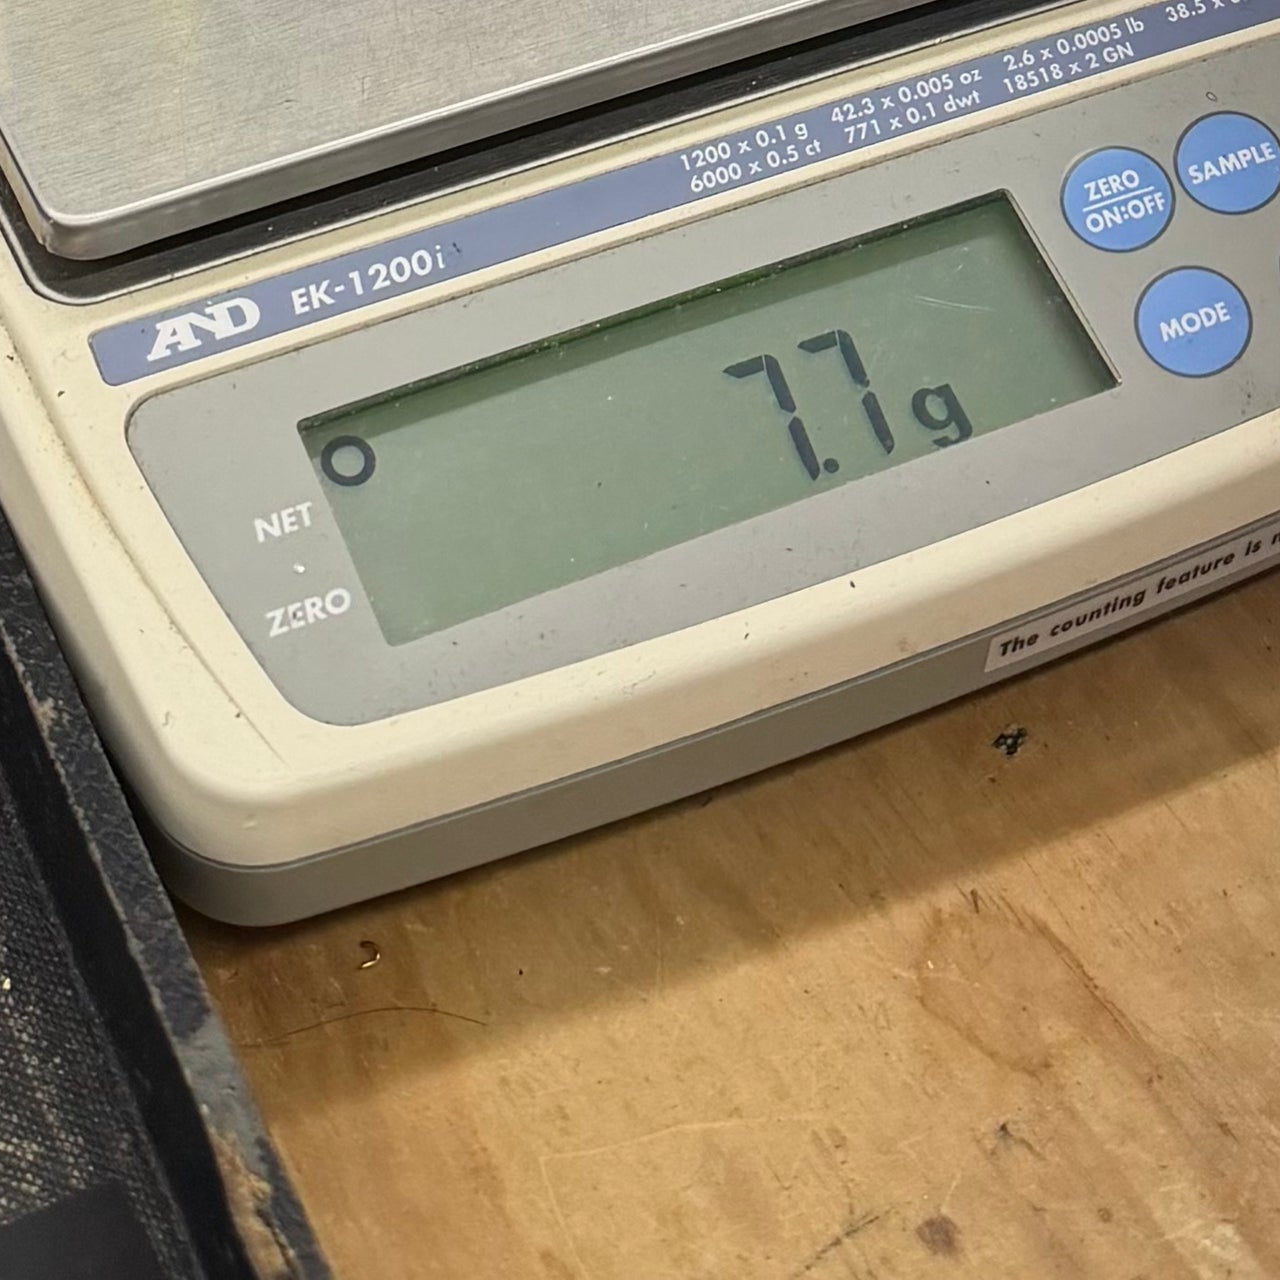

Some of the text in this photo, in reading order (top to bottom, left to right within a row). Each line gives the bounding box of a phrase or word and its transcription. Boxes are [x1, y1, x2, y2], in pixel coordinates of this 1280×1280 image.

[1002, 17, 1145, 72] 2.6 x 0.0005 lb
[1002, 41, 1135, 94] 18518 x 2 GN
[830, 68, 982, 125] 42.3 x 0.005 oz
[844, 90, 981, 144] 771 x 0.1 dwt
[680, 122, 809, 172] 1200 x 0.1 g
[690, 139, 821, 193] 6000 x 0.5 ct
[1187, 141, 1277, 185] SAMPLE
[1083, 168, 1140, 202] ZERO
[1085, 191, 1166, 234] ON:OFF
[146, 244, 446, 363] AND EK-1200i
[1159, 301, 1231, 343] MODE
[722, 328, 973, 481] 7.7 g
[252, 500, 313, 543] NET
[264, 587, 352, 638] ZERO
[999, 631, 1040, 657] The
[1049, 589, 1148, 637] counting
[1156, 552, 1236, 594] feature
[1244, 540, 1261, 556] is
